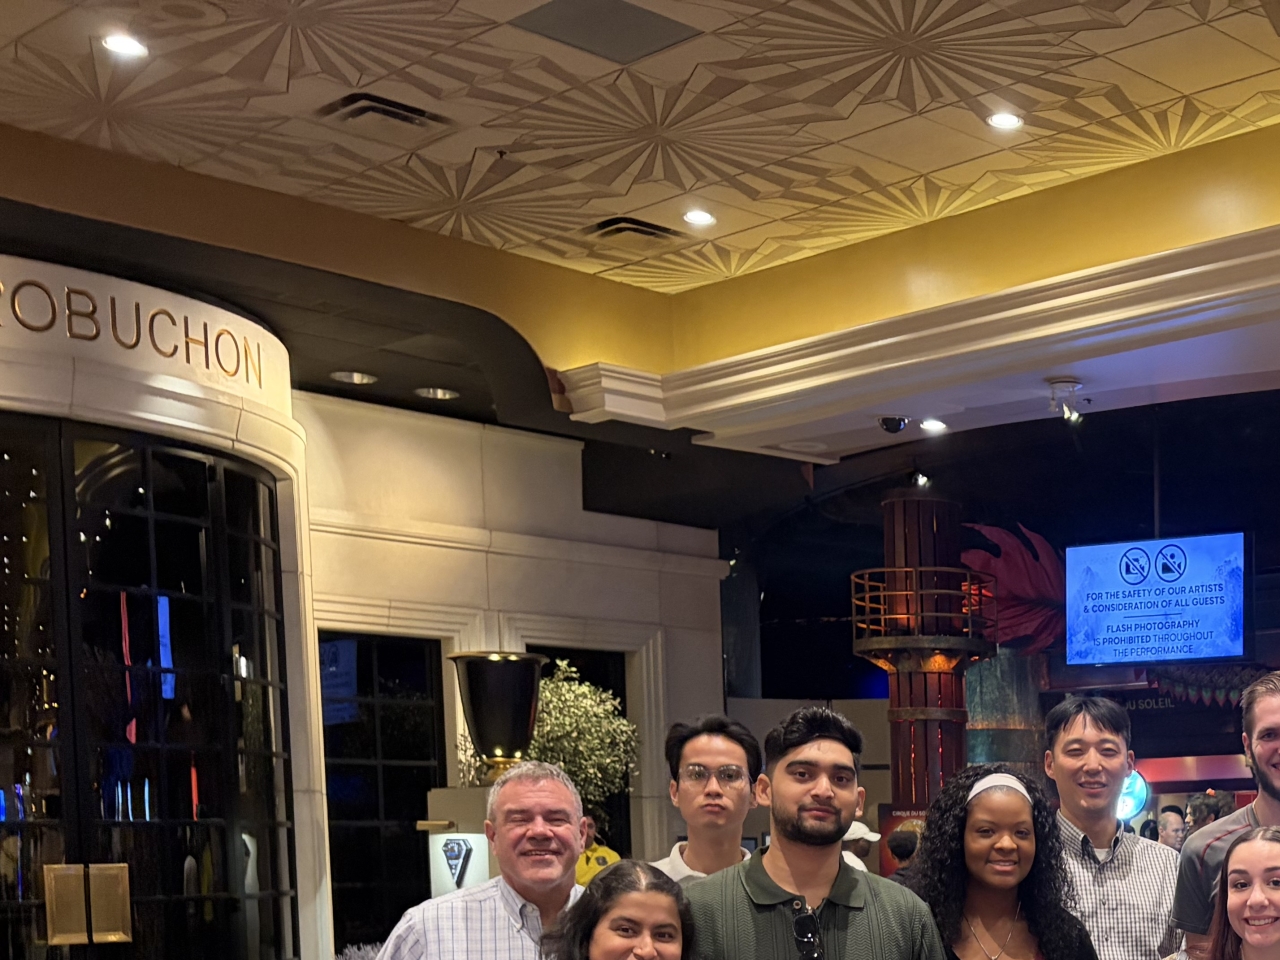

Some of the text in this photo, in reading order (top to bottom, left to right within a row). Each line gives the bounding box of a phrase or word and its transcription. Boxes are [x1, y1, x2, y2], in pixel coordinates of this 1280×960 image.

[0, 278, 262, 390] OBUCHON
[1087, 583, 1223, 601] FOR THE SAFETY OF OUR ARTISTS
[1084, 596, 1225, 613] & CONSIDERATION OF ALL GUESTS
[1107, 619, 1200, 634] FLASH PHOTOGRAPHY
[1094, 631, 1214, 646] IS PROHIBITED THROUGHOUT
[1114, 644, 1193, 657] THE PERFORMANCE
[1138, 697, 1175, 710] SOLEIL
